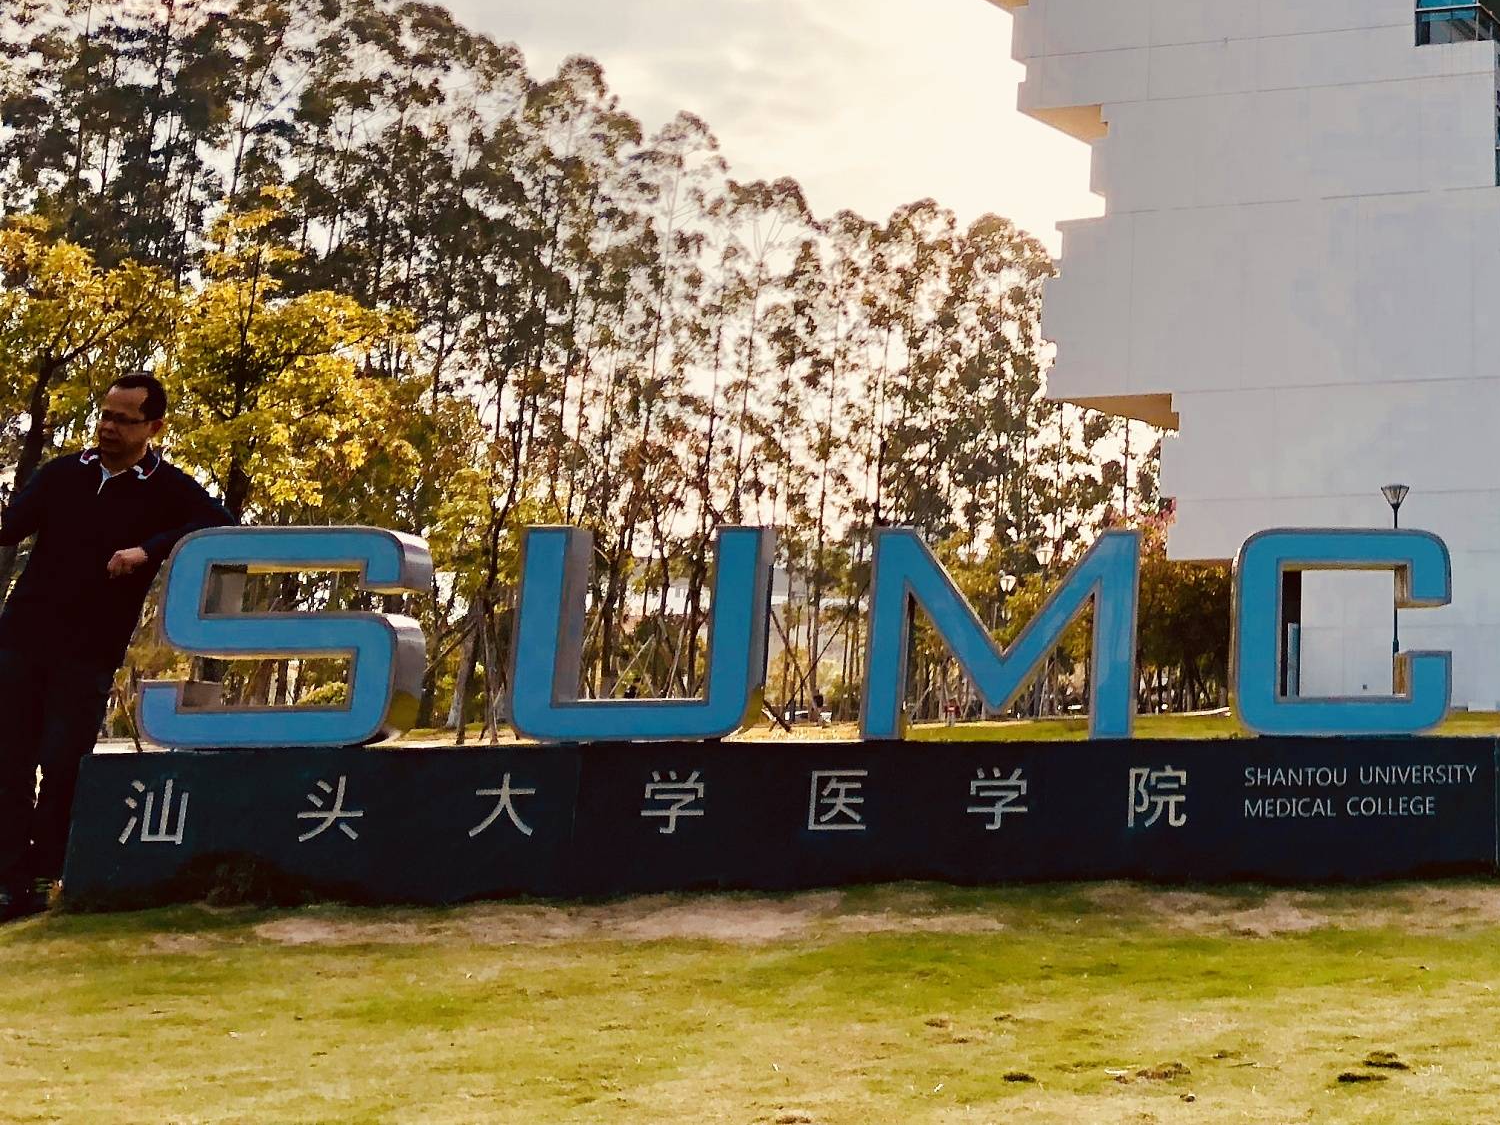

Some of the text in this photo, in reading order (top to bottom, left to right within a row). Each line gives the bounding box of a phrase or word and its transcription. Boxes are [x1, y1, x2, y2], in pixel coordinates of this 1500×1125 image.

[138, 526, 1452, 748] SUMC
[1244, 764, 1478, 787] SHANTOU UNIVERSITY
[118, 765, 1188, 845] 汕头大学医学院
[1244, 795, 1436, 818] MEDICAL COLLEGE
